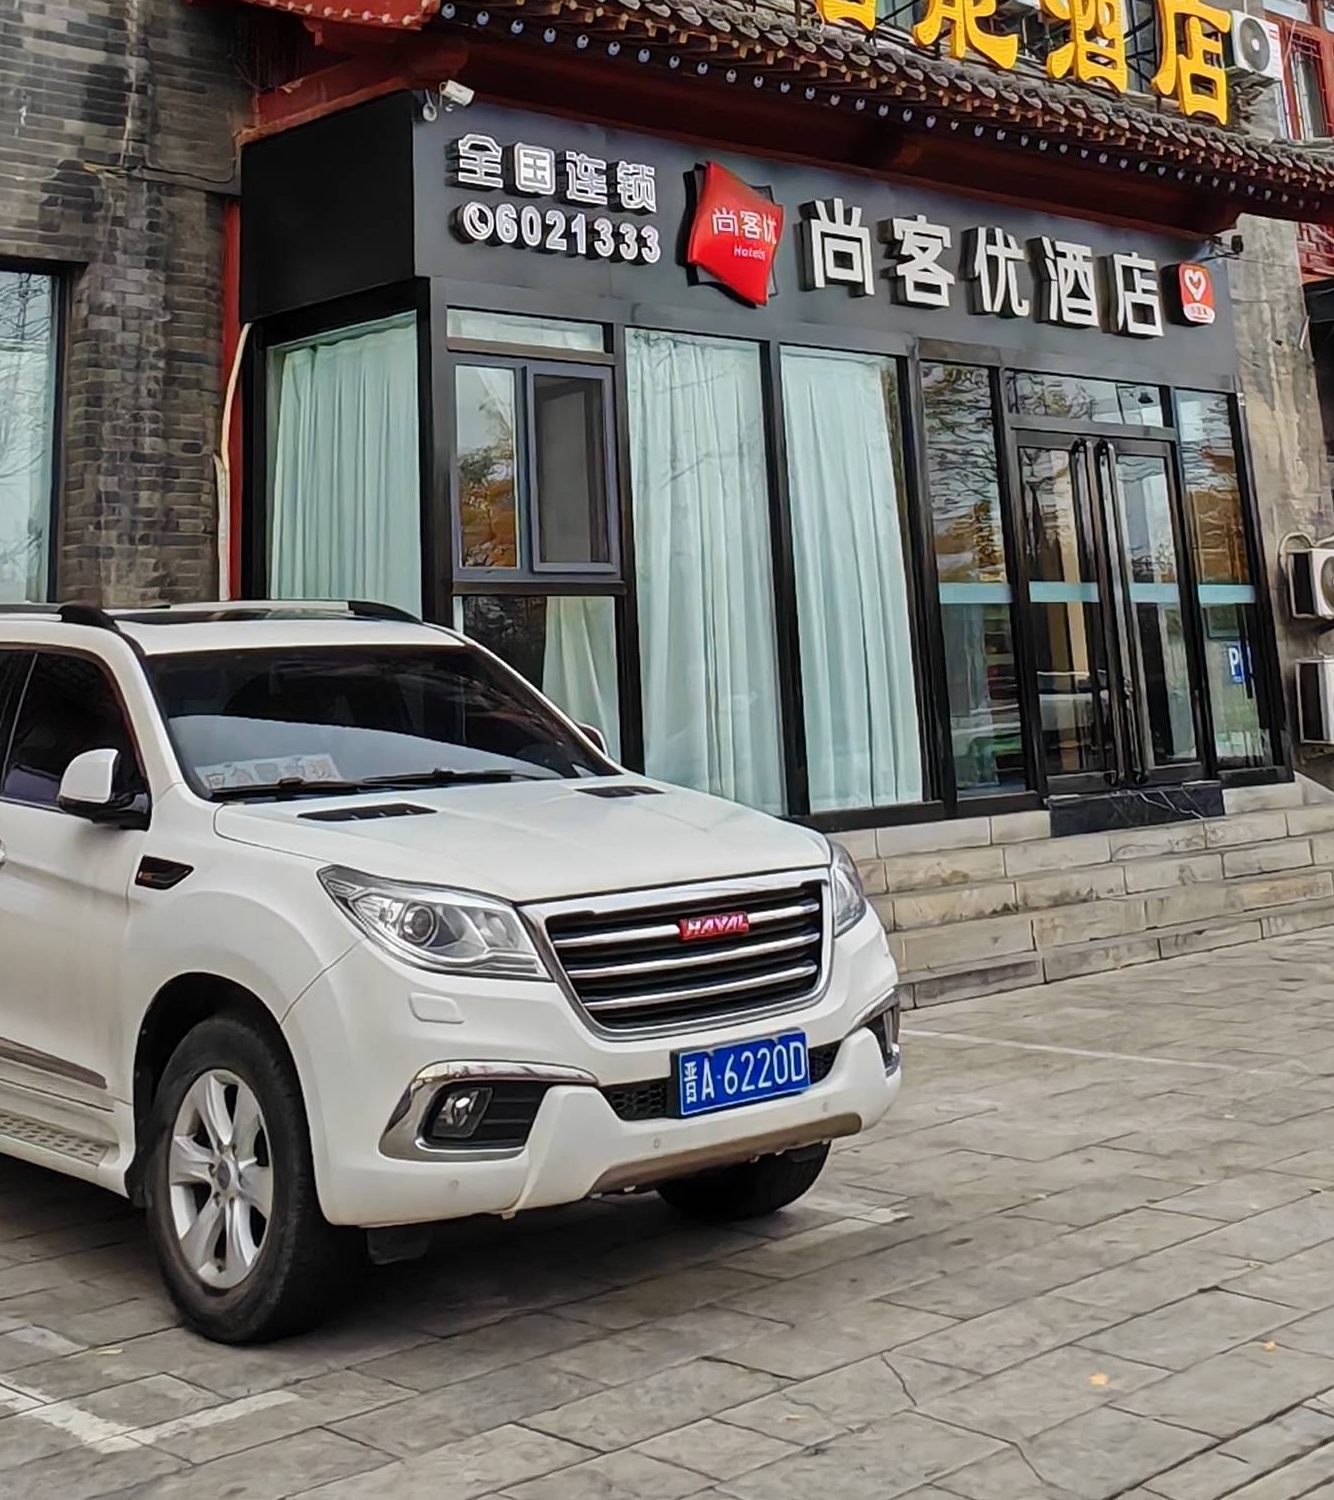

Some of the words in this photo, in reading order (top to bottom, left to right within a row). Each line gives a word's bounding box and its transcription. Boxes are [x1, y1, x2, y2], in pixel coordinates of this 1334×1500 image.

[457, 133, 657, 213] 全国连锁
[495, 203, 661, 264] 6021333
[712, 206, 777, 246] 尚客优
[809, 198, 1164, 338] 尚客优酒店
[687, 914, 747, 936] HAVAL
